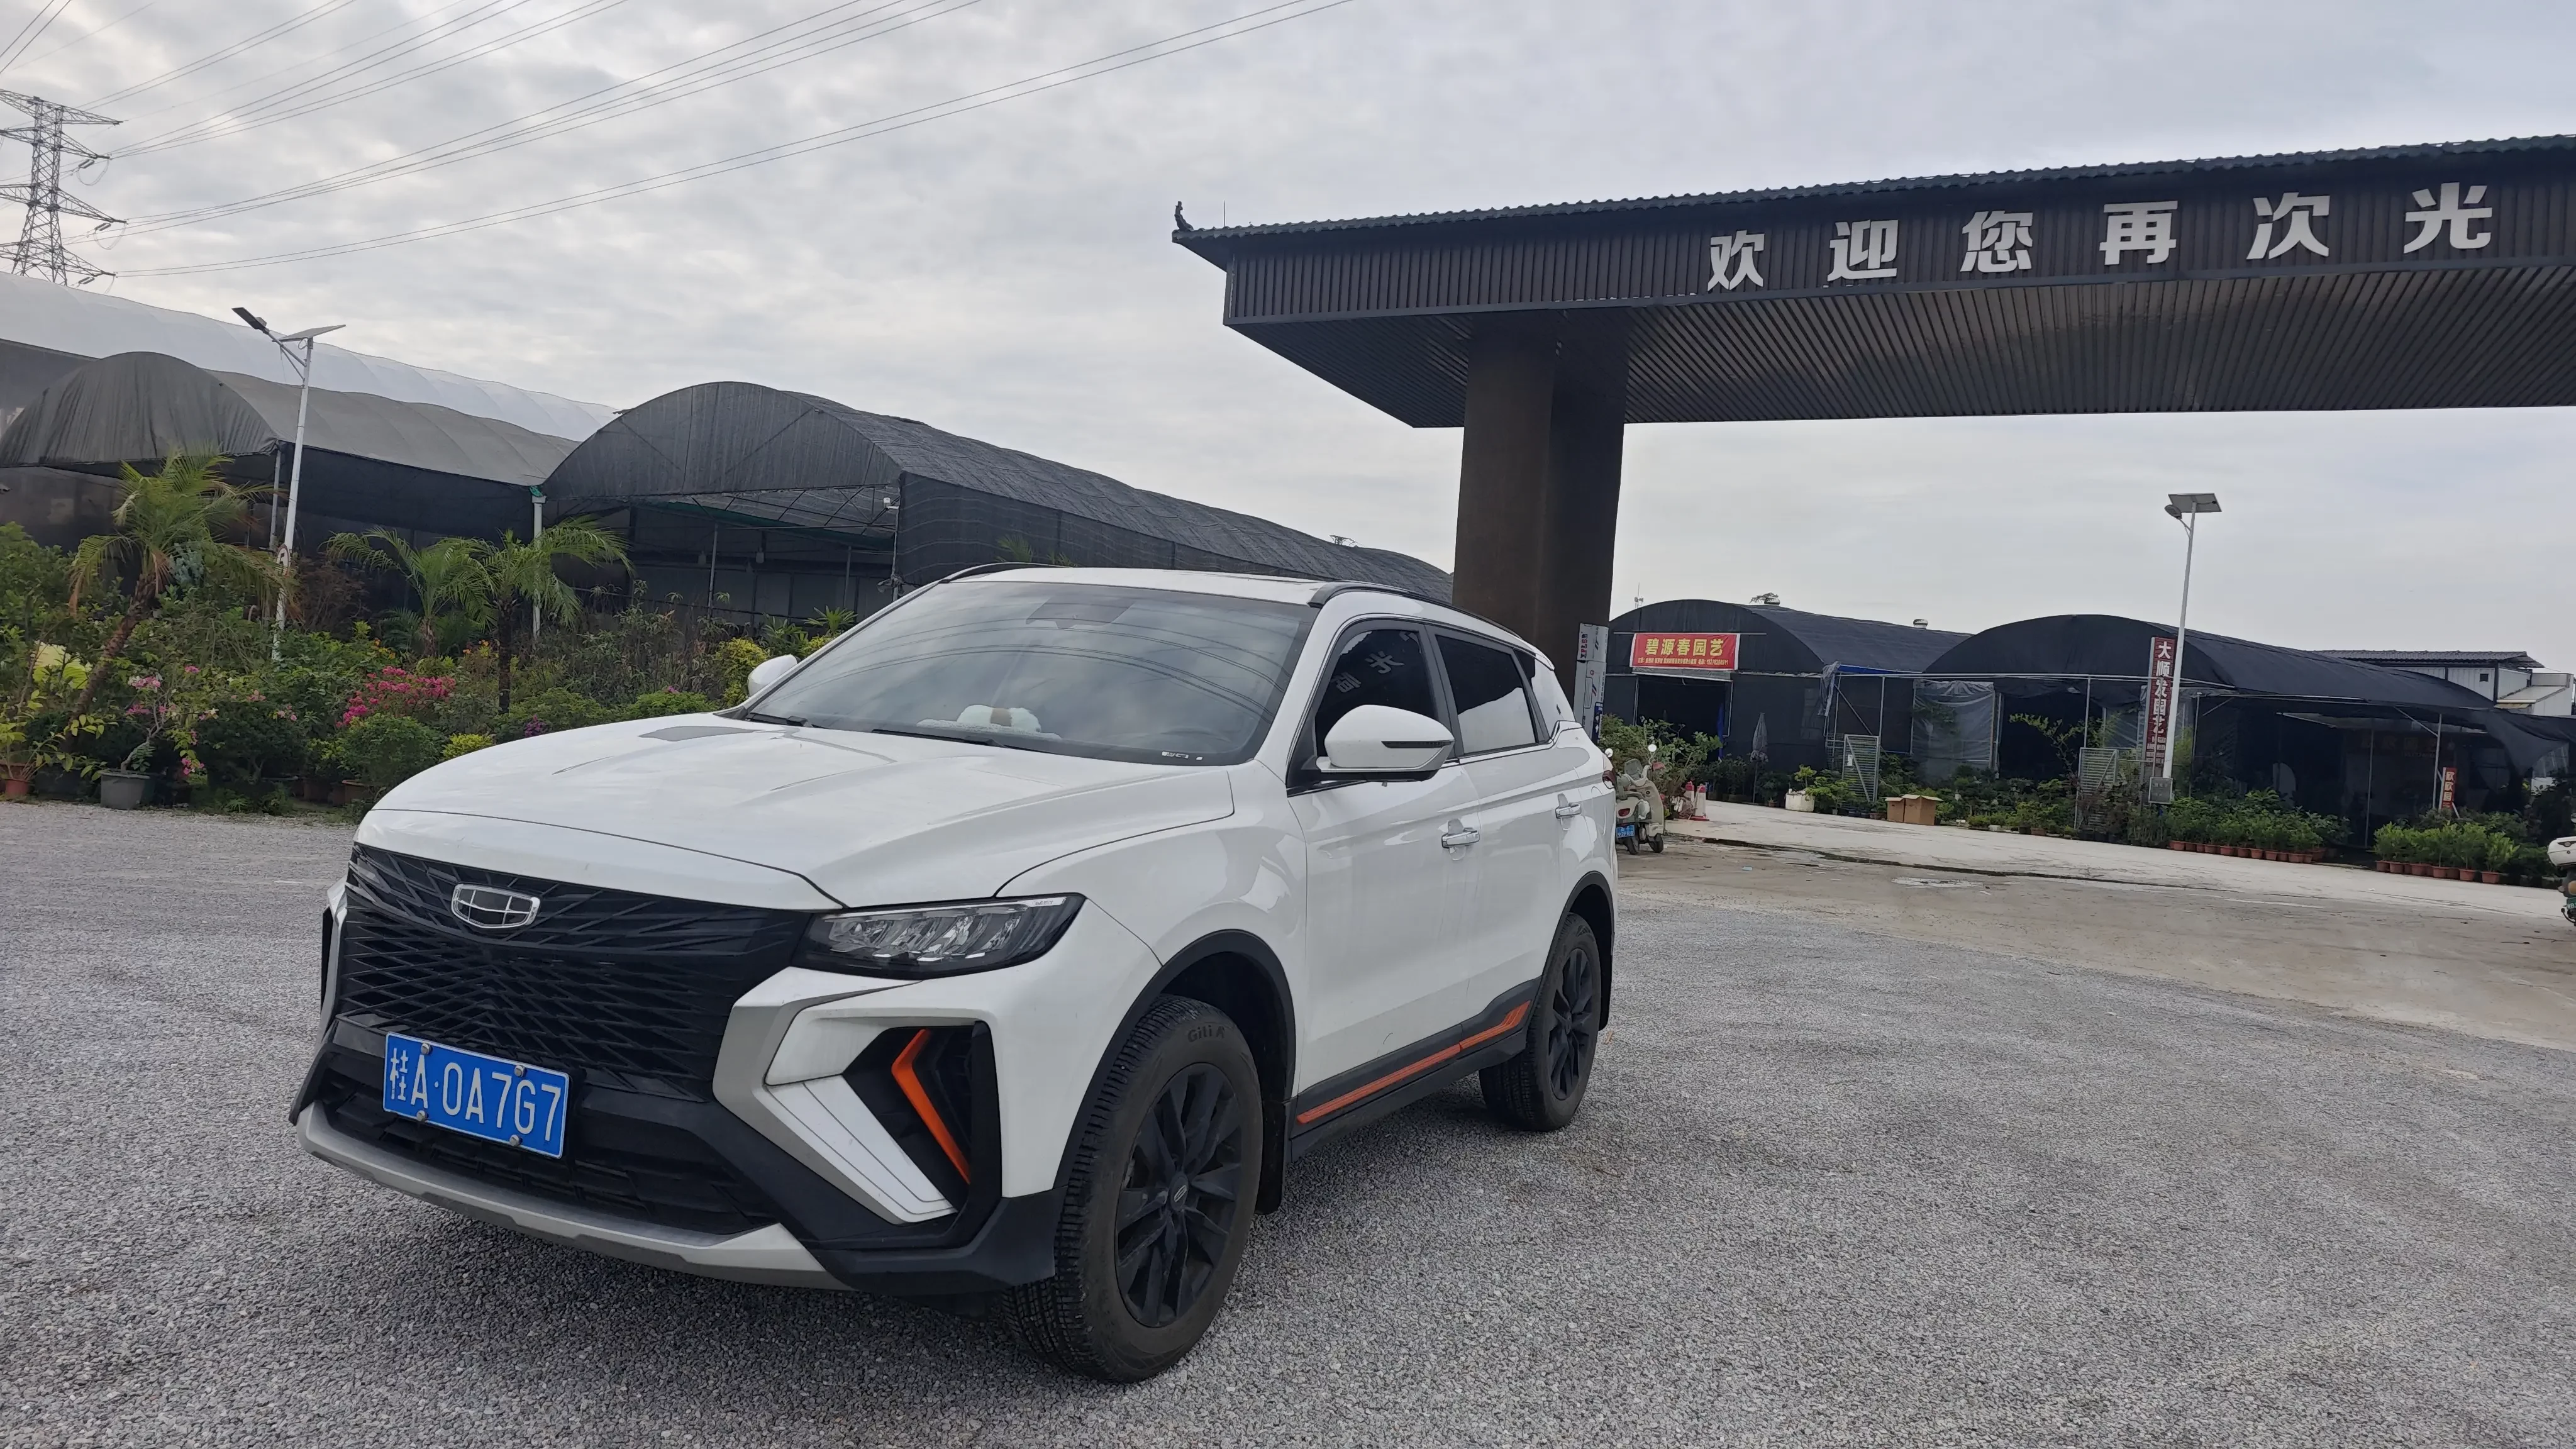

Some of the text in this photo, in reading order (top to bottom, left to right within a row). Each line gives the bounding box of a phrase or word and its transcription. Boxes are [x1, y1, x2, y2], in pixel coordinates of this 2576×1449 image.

[1707, 182, 2492, 291] 欢迎您再次光
[1645, 638, 1724, 657] 碧源春园艺
